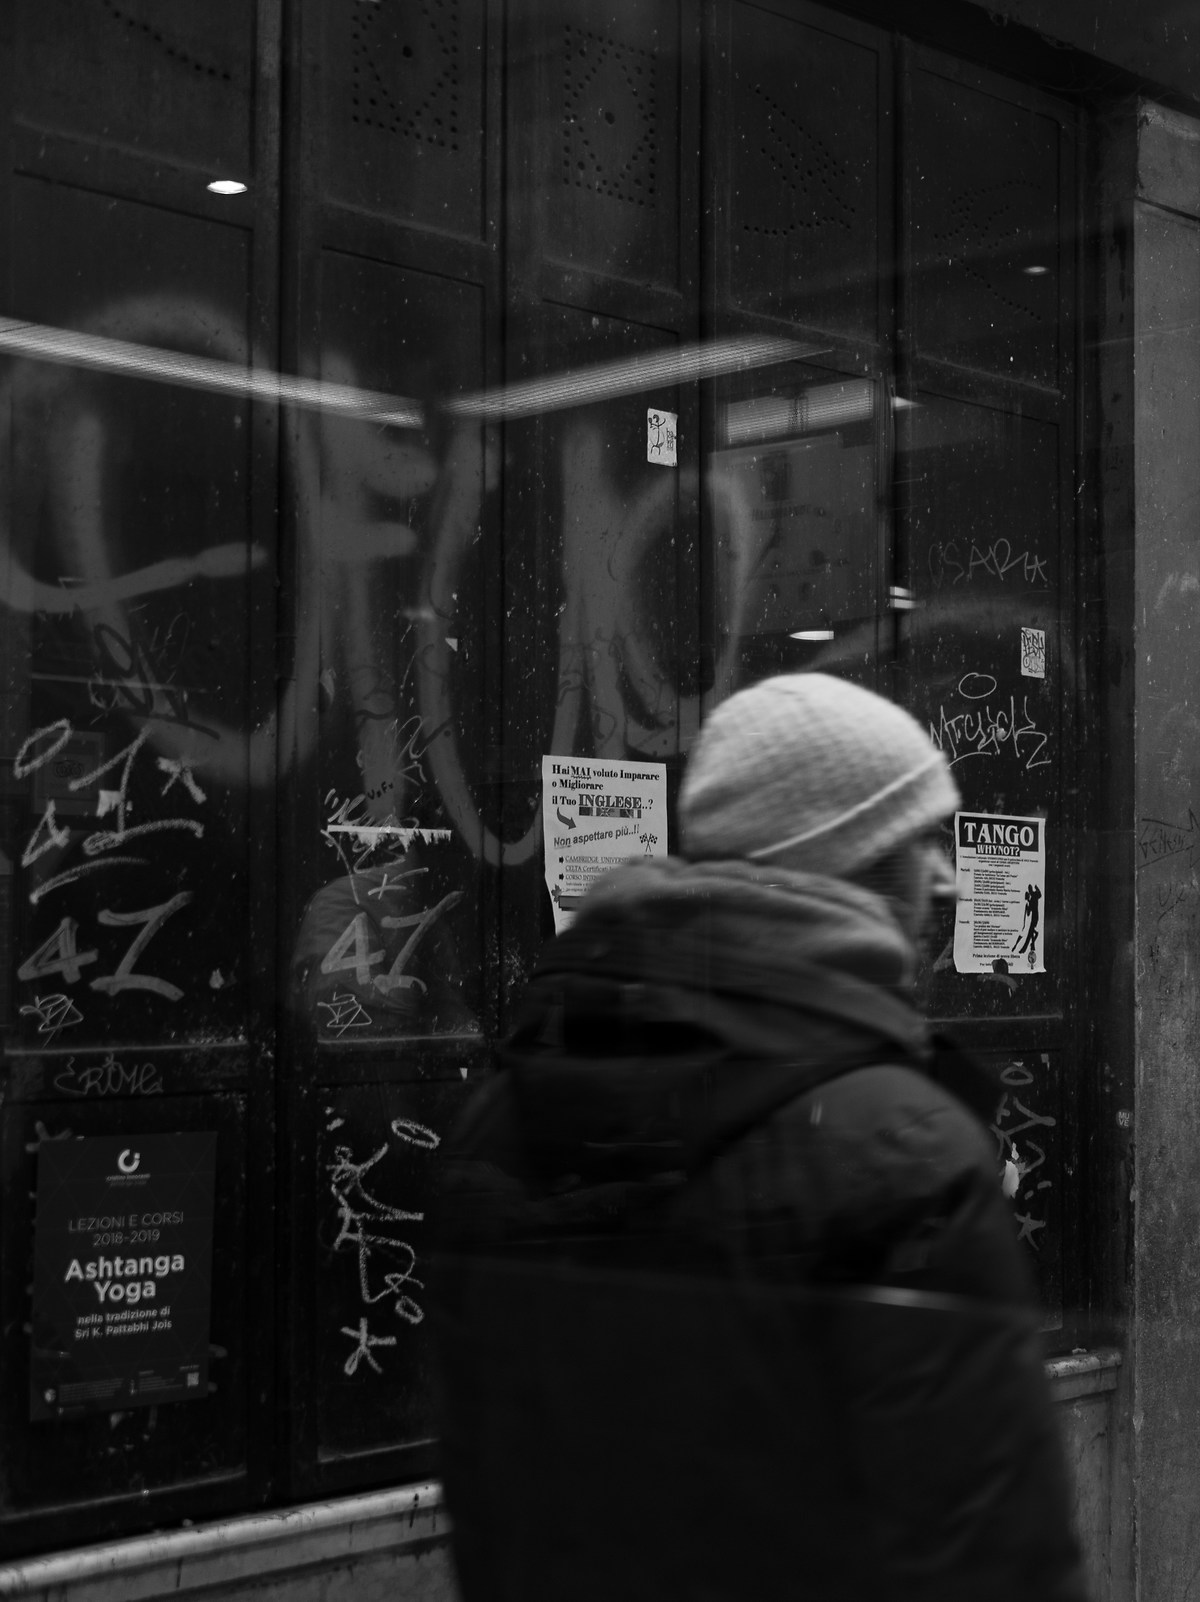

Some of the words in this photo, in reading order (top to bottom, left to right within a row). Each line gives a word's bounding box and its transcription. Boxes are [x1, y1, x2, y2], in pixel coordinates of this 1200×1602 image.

[552, 764, 570, 776] Hai
[571, 766, 590, 776] MAI
[593, 768, 618, 778] voluto
[620, 770, 660, 782] Imparare
[559, 779, 604, 792] Migliorare
[552, 795, 558, 805] il
[560, 796, 576, 806] Tuo
[554, 836, 571, 848] Non
[573, 829, 613, 846] aspettare
[964, 822, 1034, 847] TANGO
[68, 1216, 126, 1233] LEZIONI
[128, 1214, 138, 1228] E
[140, 1210, 184, 1226] CORSI
[92, 1228, 161, 1248] 2018-2019
[64, 1254, 186, 1284] Ashtanga
[94, 1280, 157, 1305] Yoga
[77, 1312, 104, 1326] nella
[106, 1307, 158, 1322] tradizione
[160, 1304, 172, 1317] di
[74, 1328, 90, 1340] Sri
[92, 1327, 104, 1339] K.
[106, 1322, 150, 1338] Pattabhi
[152, 1319, 173, 1332] Jois
